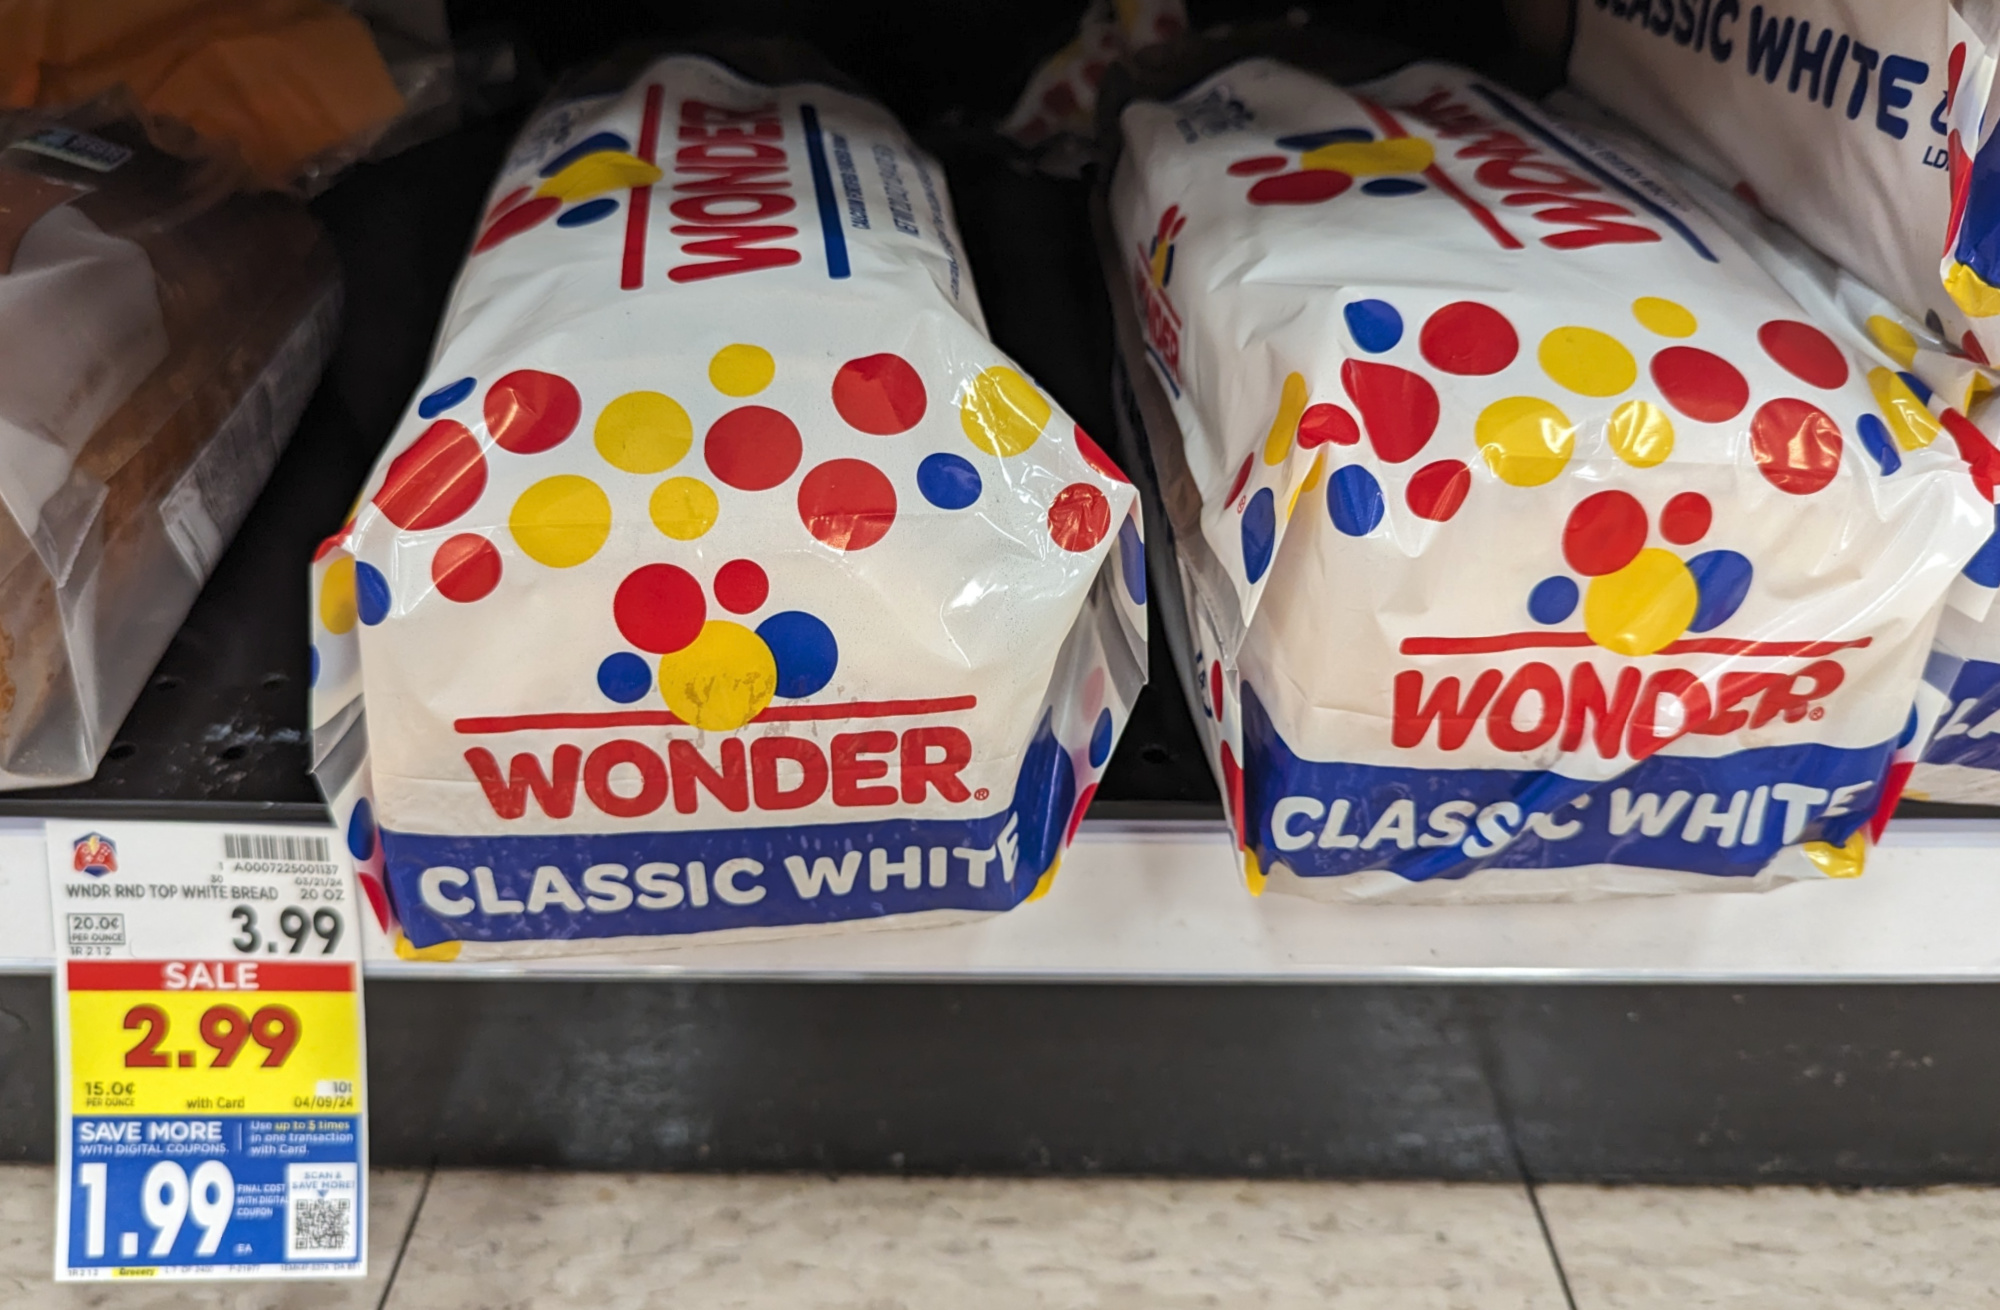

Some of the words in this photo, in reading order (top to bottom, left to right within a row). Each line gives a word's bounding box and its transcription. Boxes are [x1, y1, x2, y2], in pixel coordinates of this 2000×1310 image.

[1747, 5, 1930, 140] WHITE
[420, 856, 767, 917] CLASSIC
[785, 810, 1022, 901] WHITE
[66, 883, 112, 898] WNDR
[115, 884, 146, 899] RND
[149, 884, 178, 899] TOP
[182, 885, 228, 900] WHITE
[231, 885, 279, 901] BREAD
[300, 888, 319, 901] 20
[323, 889, 345, 902] OZ
[73, 916, 120, 930] 20.0¢
[231, 904, 345, 954] 3.99
[72, 932, 89, 942] PER
[91, 932, 123, 942] OUNCE
[164, 962, 261, 990] SALE
[122, 1003, 303, 1069] 2.99
[84, 1081, 136, 1096] 15.0¢
[86, 1098, 103, 1107] PER
[105, 1098, 136, 1108] OUNCE
[187, 1096, 213, 1109] with
[216, 1096, 245, 1109] Card
[293, 1096, 354, 1110] 04/09/24
[80, 1121, 143, 1142] SAVE
[149, 1121, 223, 1142] MORE
[250, 1120, 273, 1132] Use
[275, 1121, 290, 1133] up
[293, 1120, 306, 1132] to
[318, 1120, 350, 1131] times
[250, 1132, 262, 1144] in
[265, 1133, 286, 1143] one
[289, 1131, 354, 1143] transaction
[79, 1143, 113, 1155] WITH
[115, 1143, 164, 1154] DIGITAL
[250, 1144, 277, 1156] with
[304, 1171, 333, 1180] SCAN
[237, 1183, 261, 1193] FINAL
[263, 1183, 286, 1193] COST
[292, 1181, 318, 1190] SAVE
[237, 1195, 259, 1206] WITH
[80, 1159, 235, 1258] 1.99
[237, 1207, 273, 1217] COUPON
[238, 1243, 253, 1254] EA
[119, 1266, 155, 1277] Grocery
